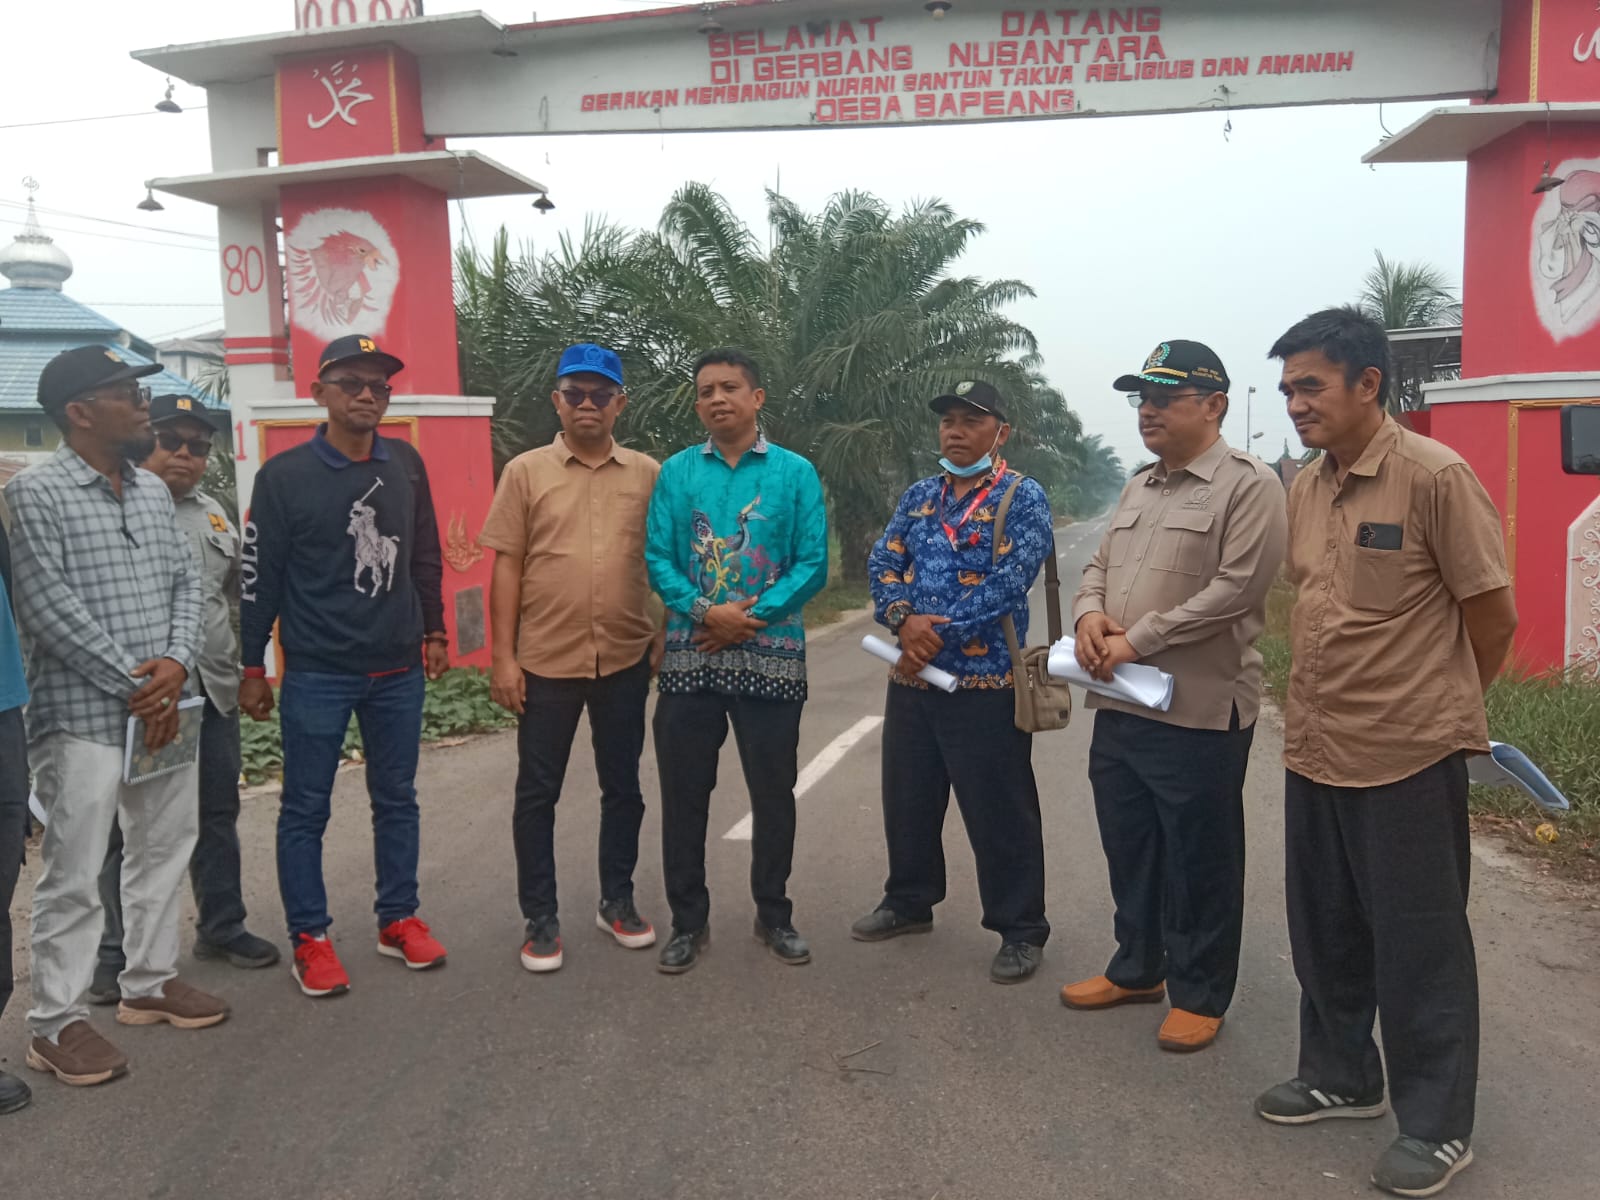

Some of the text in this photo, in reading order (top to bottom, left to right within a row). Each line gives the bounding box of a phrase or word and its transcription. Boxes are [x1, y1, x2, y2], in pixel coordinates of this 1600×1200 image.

[708, 7, 1161, 57] SELAMAT DATANG
[580, 89, 678, 112] GERAKAN
[684, 80, 810, 106] MEMBANGUN
[816, 76, 895, 97] NURANI
[904, 70, 992, 92] SANTUN
[1085, 59, 1194, 83] RELIGIUS
[1201, 56, 1248, 77] DAN
[1256, 51, 1354, 75] AMANAH
[710, 35, 1166, 84] DI GERBANG NUSANTARA
[816, 89, 1075, 122] DESA BAPEANG
[223, 244, 264, 297] 80
